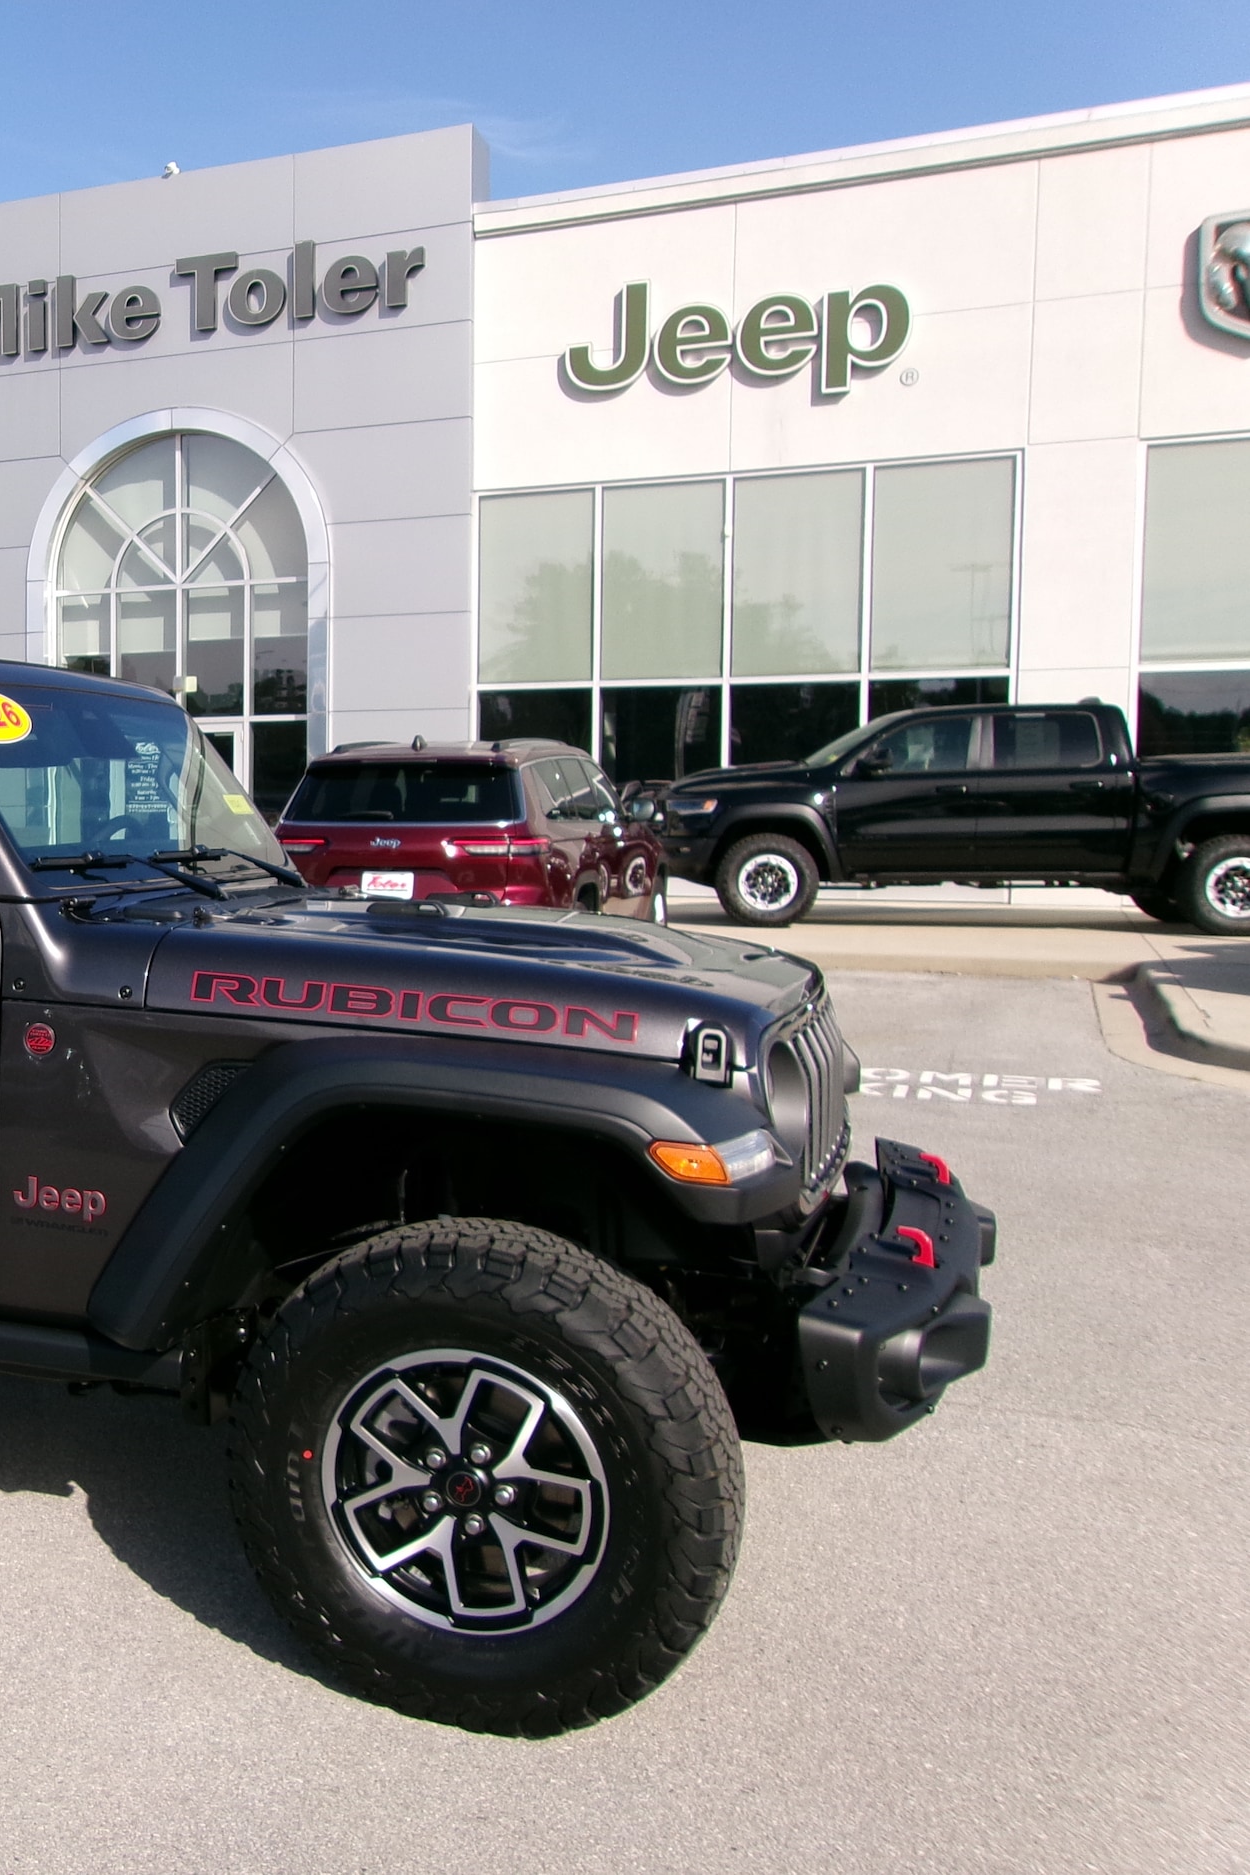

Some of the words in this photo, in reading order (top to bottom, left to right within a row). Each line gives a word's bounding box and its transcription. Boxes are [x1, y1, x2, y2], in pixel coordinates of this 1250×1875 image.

[174, 239, 426, 332] Toler
[564, 279, 912, 394] Jeep
[370, 836, 401, 849] Jeep
[189, 970, 639, 1044] RUBICON
[13, 1175, 106, 1222] Jeep
